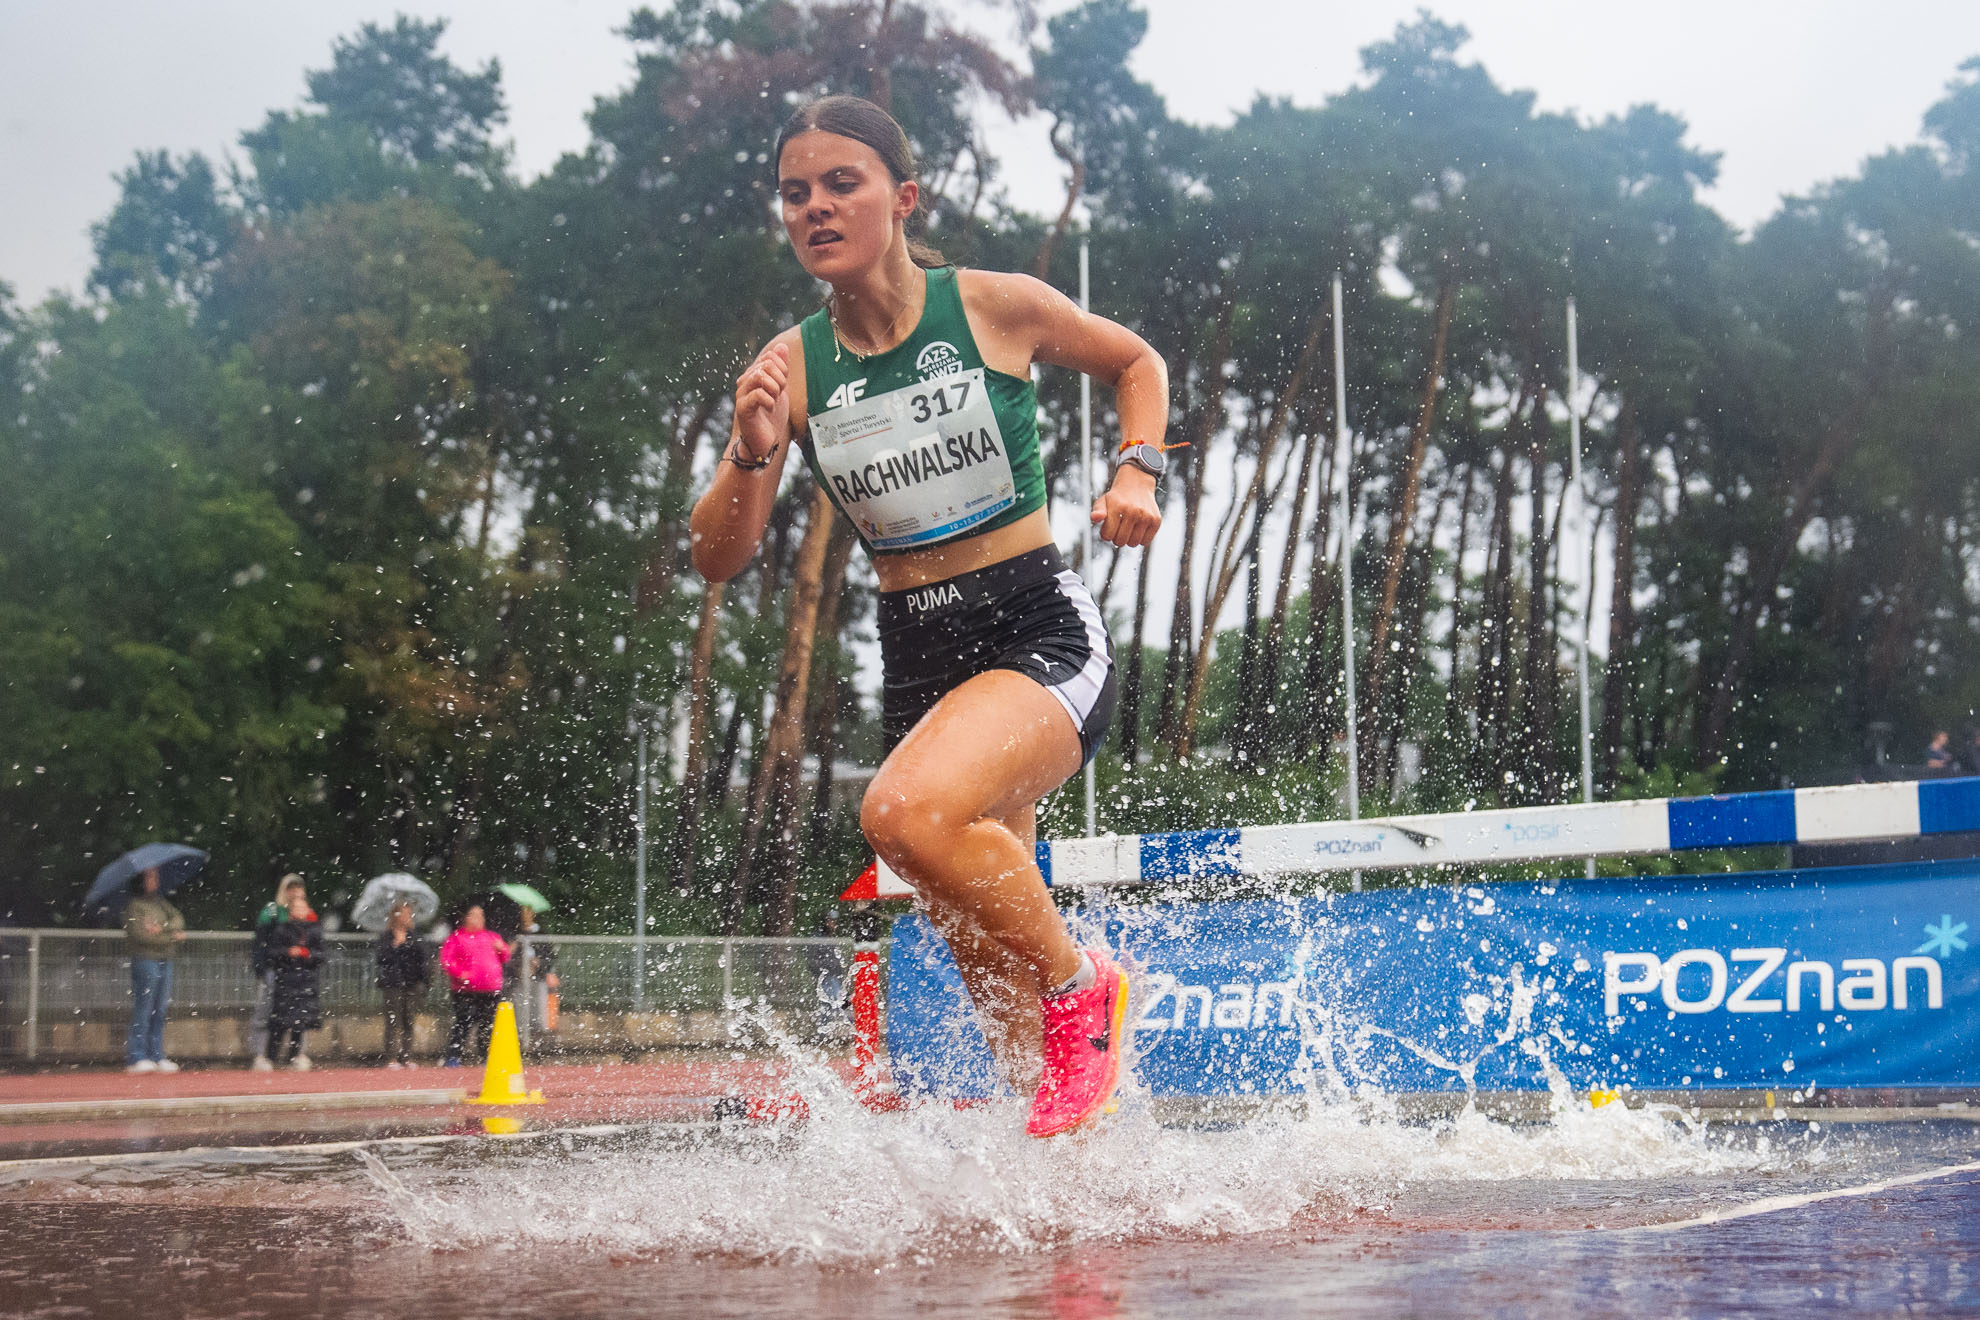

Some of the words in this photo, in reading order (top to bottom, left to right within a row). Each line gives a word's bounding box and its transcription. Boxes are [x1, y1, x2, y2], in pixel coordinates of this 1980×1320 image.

[924, 346, 950, 364] AZS
[826, 377, 868, 409] 4F
[910, 382, 971, 424] 317
[831, 427, 1000, 505] RACHWALSKA
[906, 583, 964, 614] PUMA
[1135, 973, 1295, 1030] Znan
[1603, 947, 1943, 1016] POZnan
